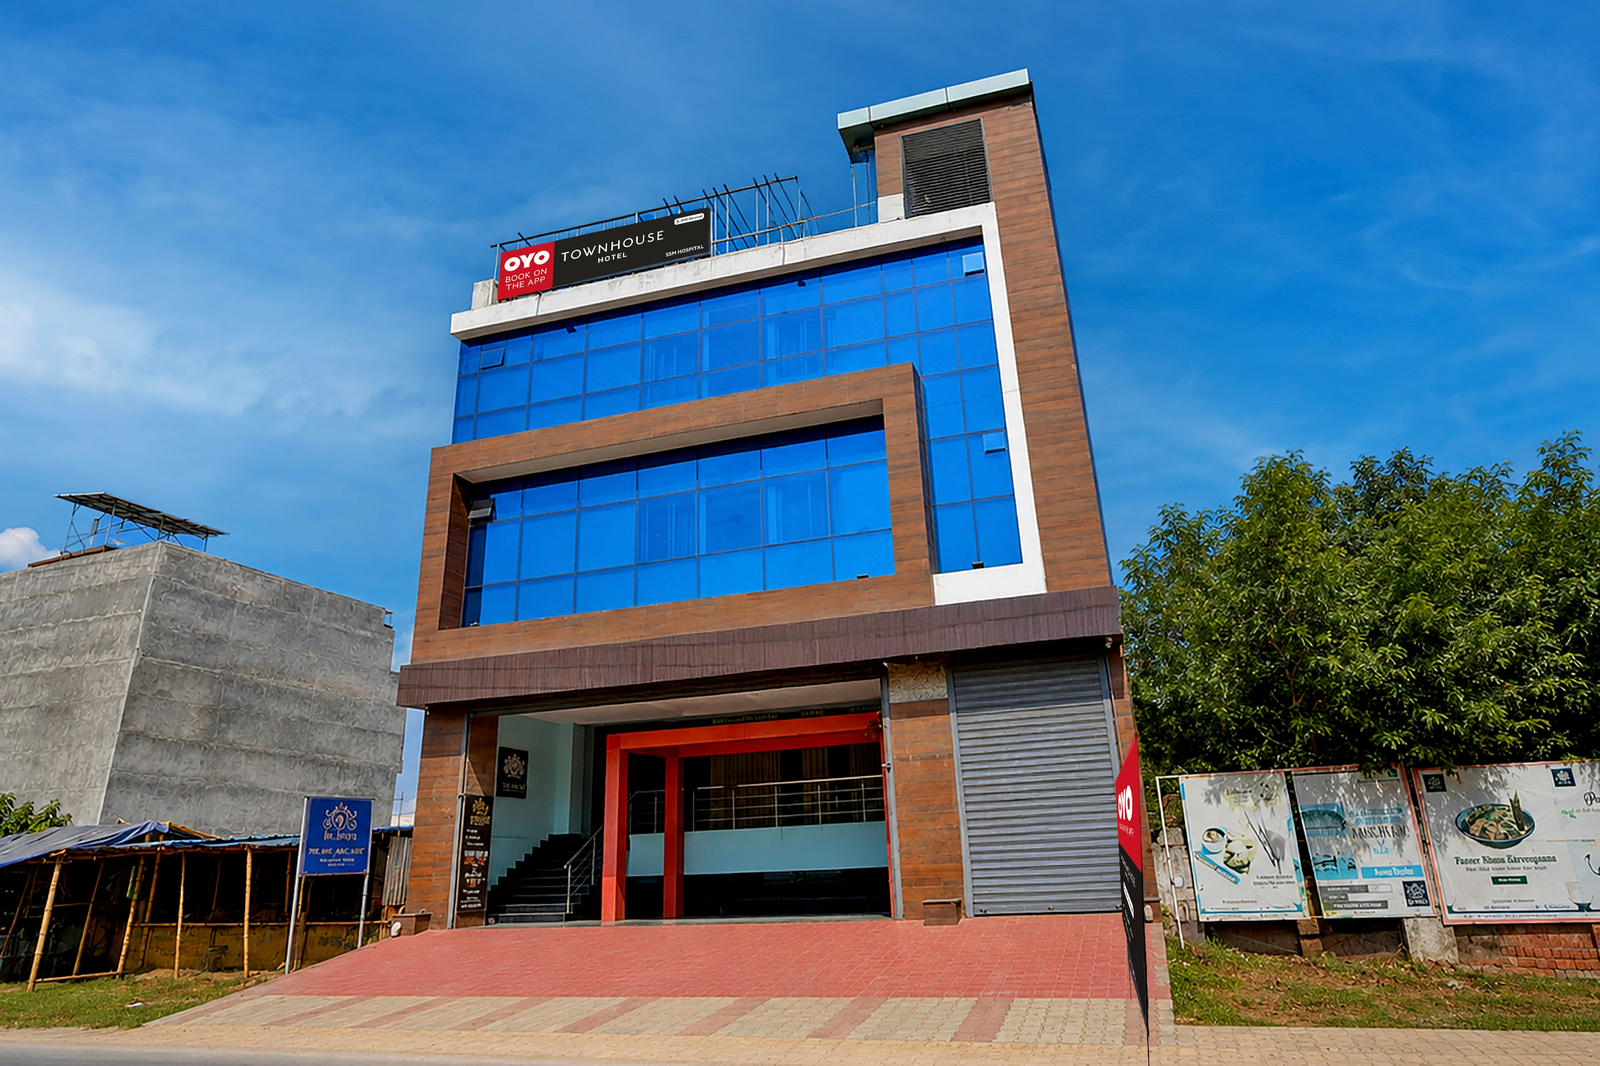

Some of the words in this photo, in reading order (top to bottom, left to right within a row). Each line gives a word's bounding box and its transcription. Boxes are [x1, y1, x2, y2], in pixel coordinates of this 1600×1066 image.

[561, 230, 664, 262] TOWNHOUSE
[677, 244, 704, 255] HOSPITAL
[504, 250, 550, 272] OYO
[597, 252, 627, 263] HOTEL
[505, 271, 531, 284] BOOK
[533, 268, 547, 277] ON
[505, 281, 525, 291] THE
[527, 276, 546, 287] APP
[1118, 785, 1133, 821] OYO
